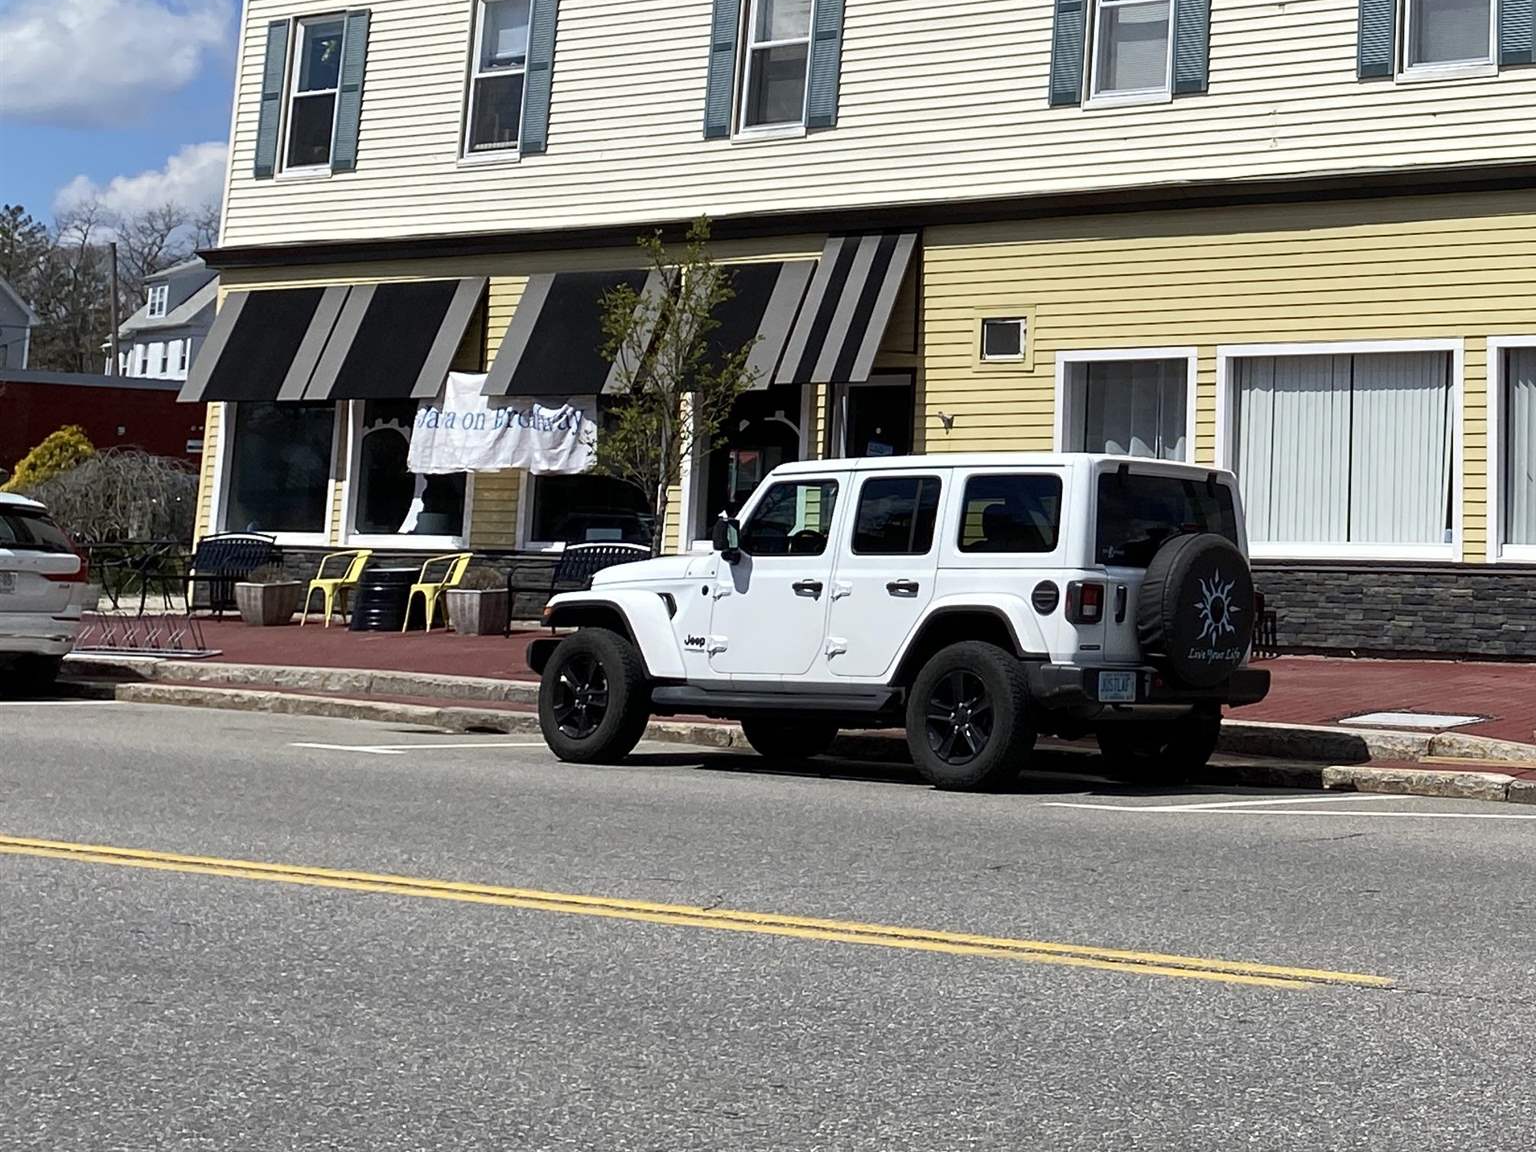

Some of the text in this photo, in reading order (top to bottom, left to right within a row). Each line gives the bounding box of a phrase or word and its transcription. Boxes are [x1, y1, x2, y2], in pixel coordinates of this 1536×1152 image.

[418, 405, 457, 429] Jaa
[462, 412, 486, 430] on
[684, 634, 706, 648] Jeep
